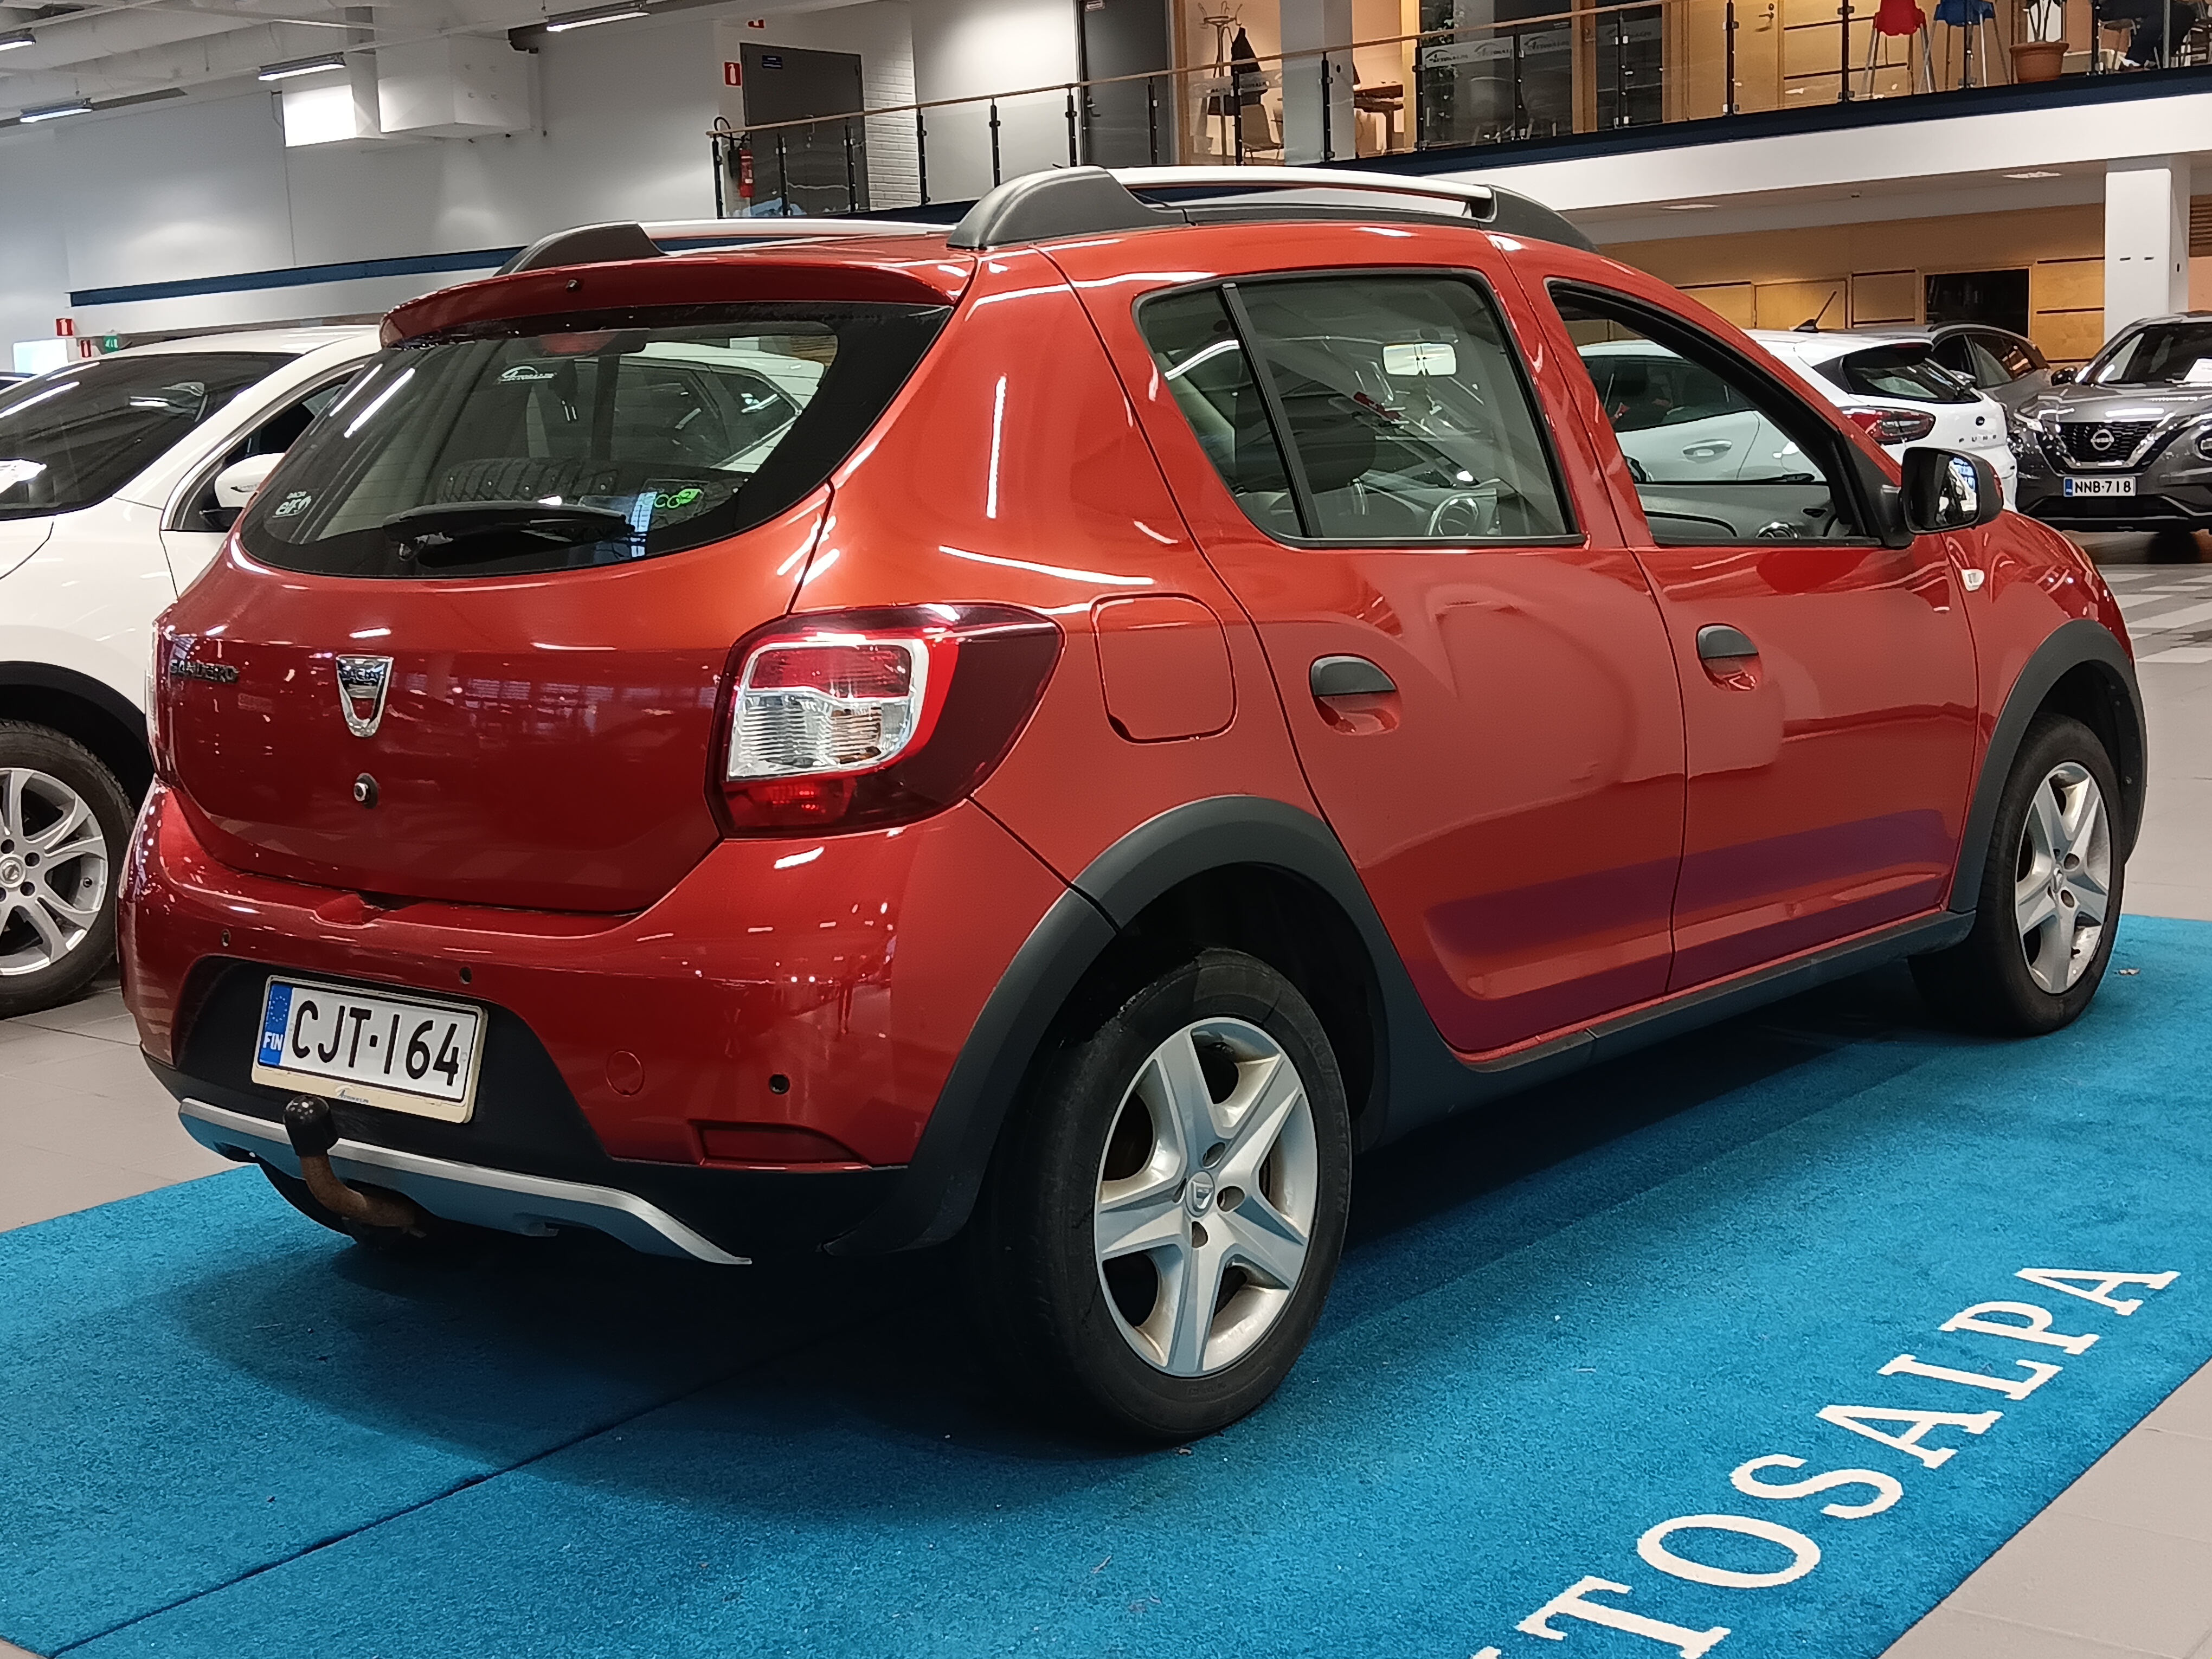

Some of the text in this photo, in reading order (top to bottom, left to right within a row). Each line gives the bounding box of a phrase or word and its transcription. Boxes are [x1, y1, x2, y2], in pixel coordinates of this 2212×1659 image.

[2075, 480, 2131, 493] NNB-718
[262, 1031, 284, 1051] FIN
[292, 1000, 459, 1086] CJT-164
[1469, 1268, 2182, 1659] TOSALPA
